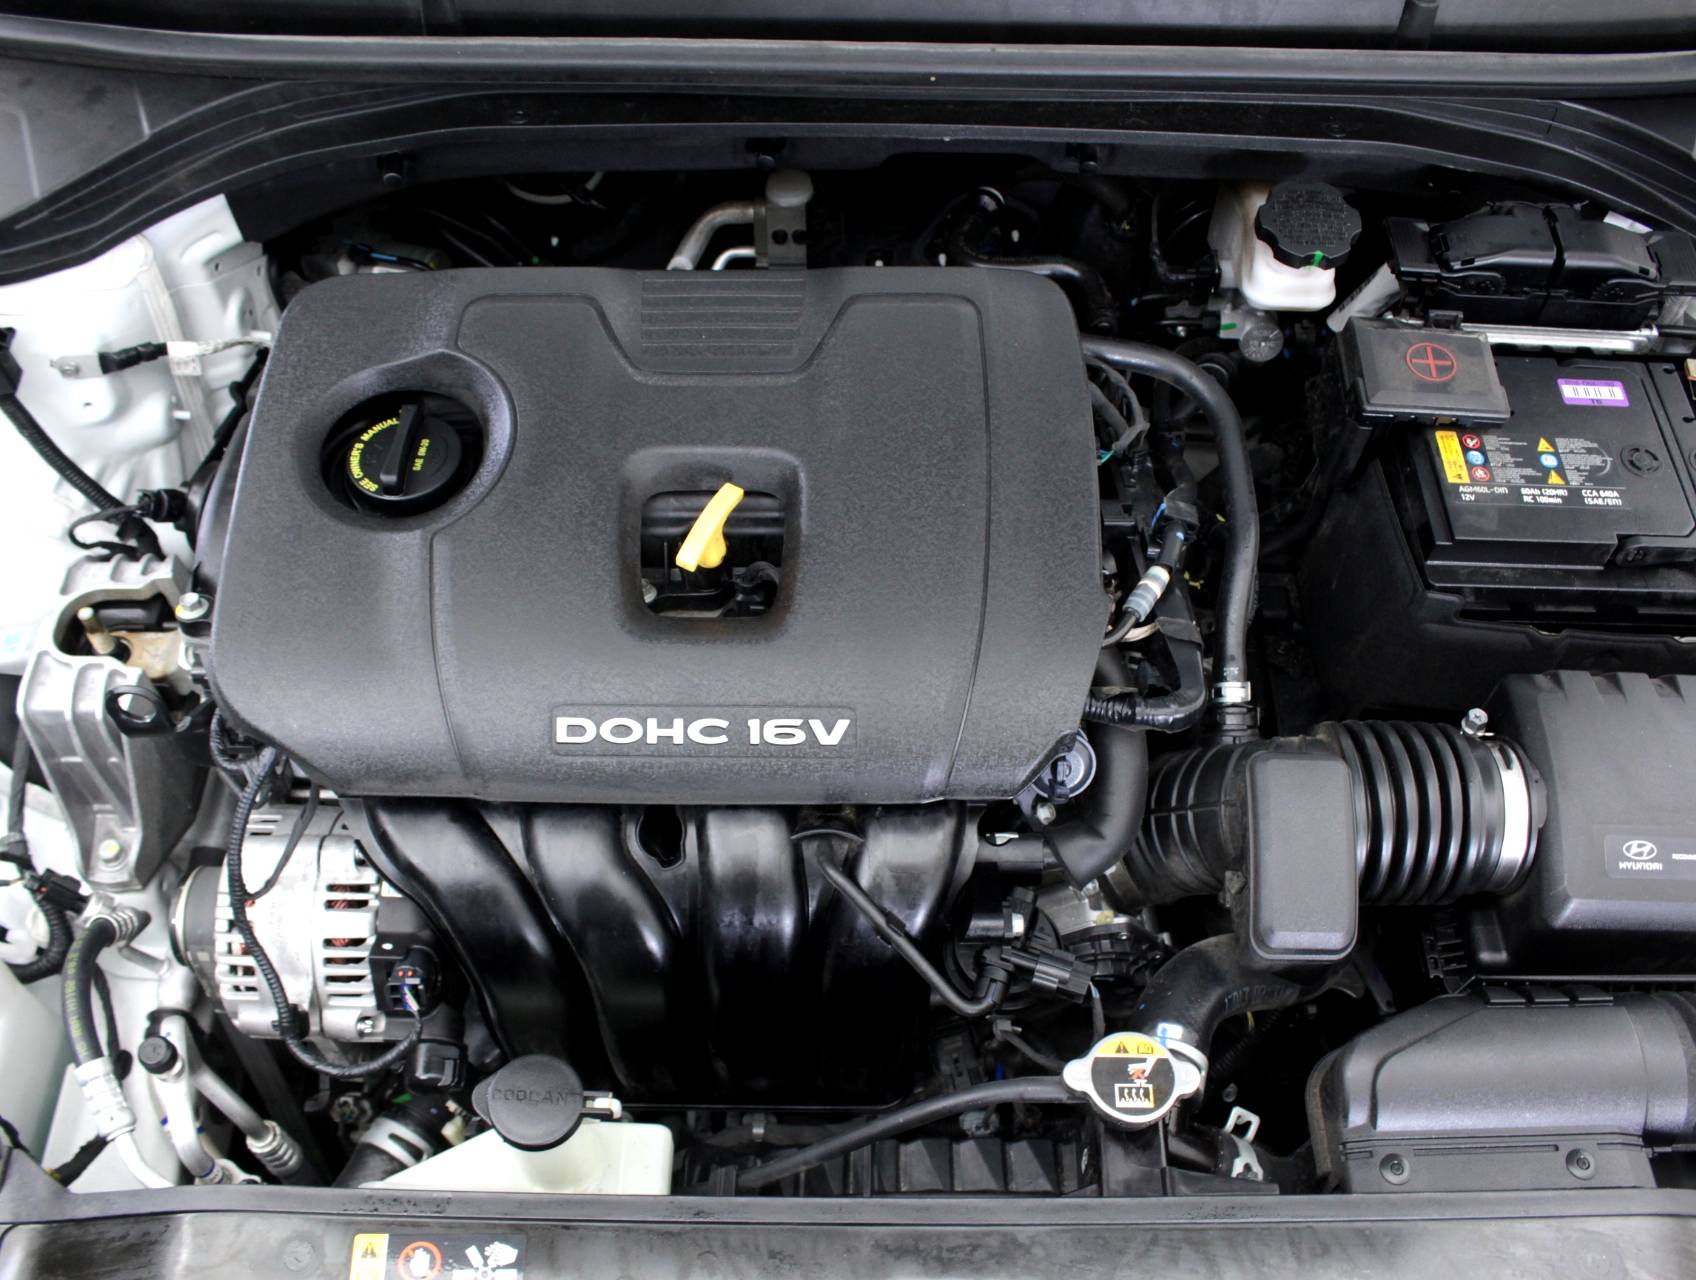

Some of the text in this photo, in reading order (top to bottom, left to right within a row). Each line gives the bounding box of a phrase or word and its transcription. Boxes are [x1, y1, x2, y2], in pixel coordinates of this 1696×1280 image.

[350, 417, 400, 491] SEE OWNER'S MANUAL
[1461, 493, 1476, 502] 12V
[1582, 489, 1599, 498] CCA
[1523, 496, 1535, 504] RC
[556, 717, 850, 746] DOHC 16V
[1619, 861, 1663, 871] HYUNDAI
